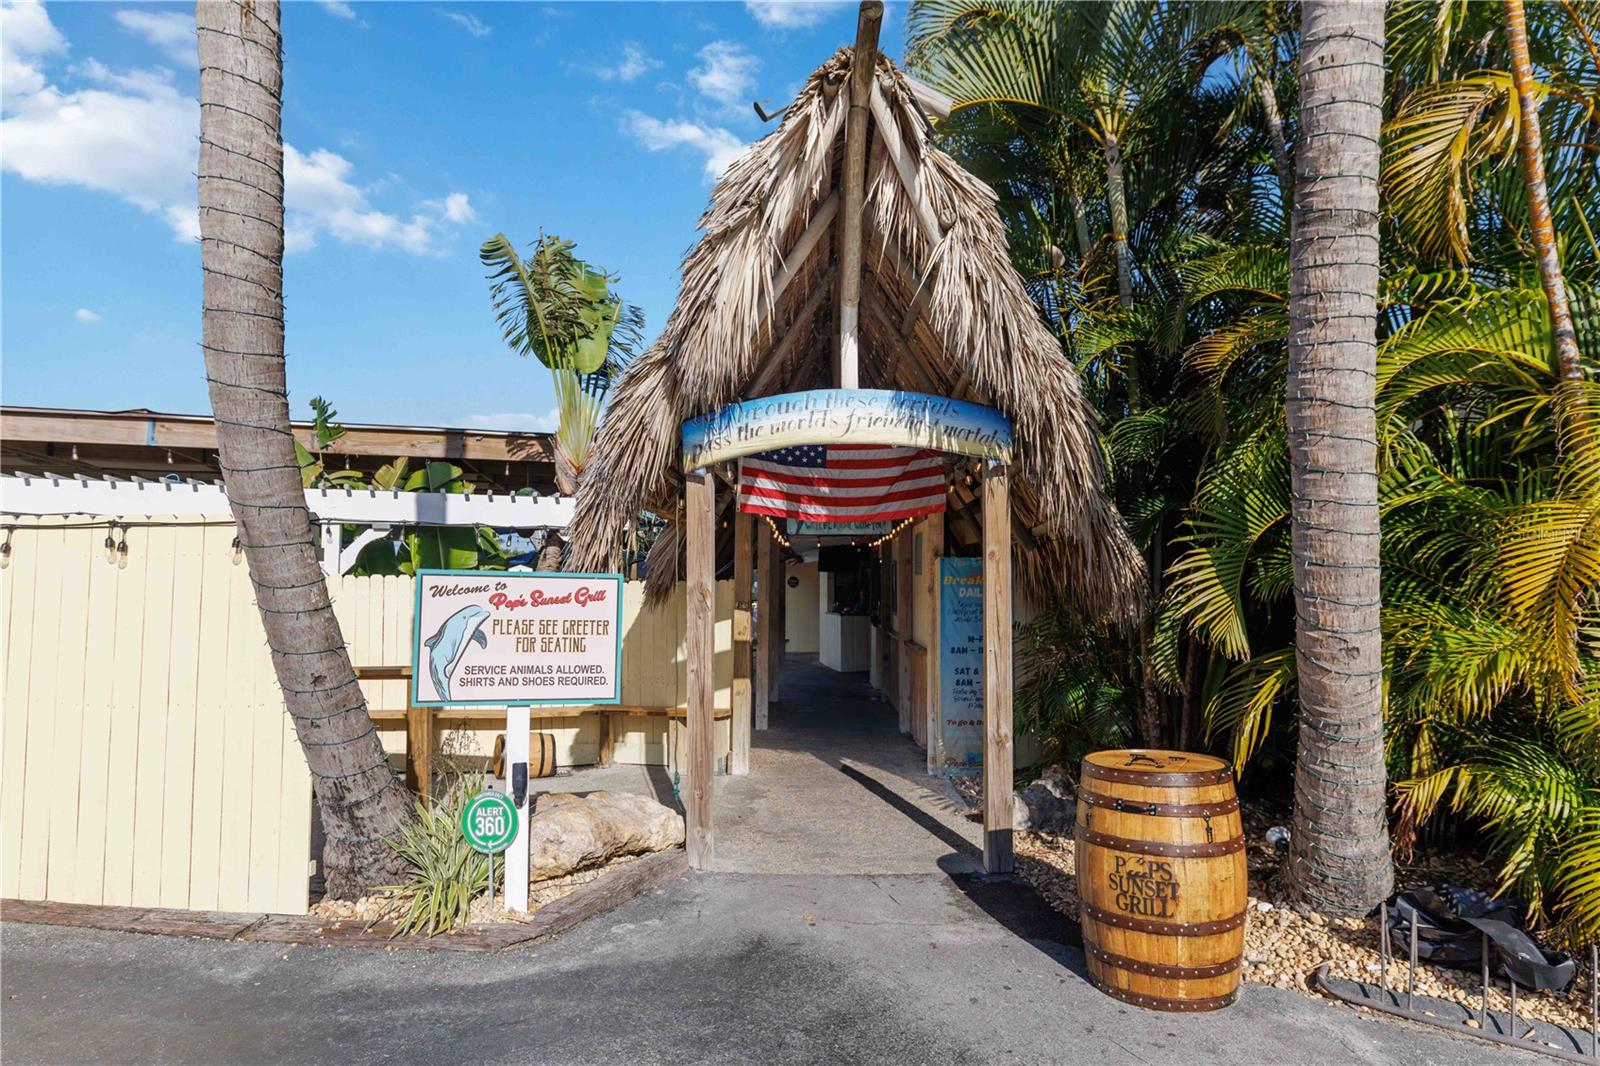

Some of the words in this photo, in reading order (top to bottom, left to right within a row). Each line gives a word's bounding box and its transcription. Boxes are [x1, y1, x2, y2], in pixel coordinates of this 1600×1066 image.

[825, 390, 878, 409] these
[737, 422, 764, 440] the
[429, 584, 490, 599] Welcome
[495, 581, 508, 592] to
[529, 589, 573, 608] Sunset
[574, 586, 607, 607] Grill
[492, 619, 534, 636] PLEASE
[538, 619, 558, 636] SEE
[562, 619, 610, 636] GREETER
[515, 637, 537, 653] FOR
[540, 637, 587, 653] SEATING
[950, 646, 968, 654] 8AM
[464, 665, 508, 675] SERVICE
[509, 664, 554, 675] ANIMALS
[555, 664, 605, 675] ALLOWED.
[954, 667, 970, 675] SAT
[973, 667, 979, 675] &
[459, 676, 496, 687] SHIRTS
[497, 676, 520, 687] AND
[522, 676, 555, 687] SHOES
[557, 675, 609, 686] REQUIRED.
[955, 679, 973, 687] 8AM
[476, 807, 504, 817] ALERT
[475, 817, 505, 836] 360
[1108, 872, 1180, 900] SUNSET
[1116, 892, 1174, 918] GRILL
